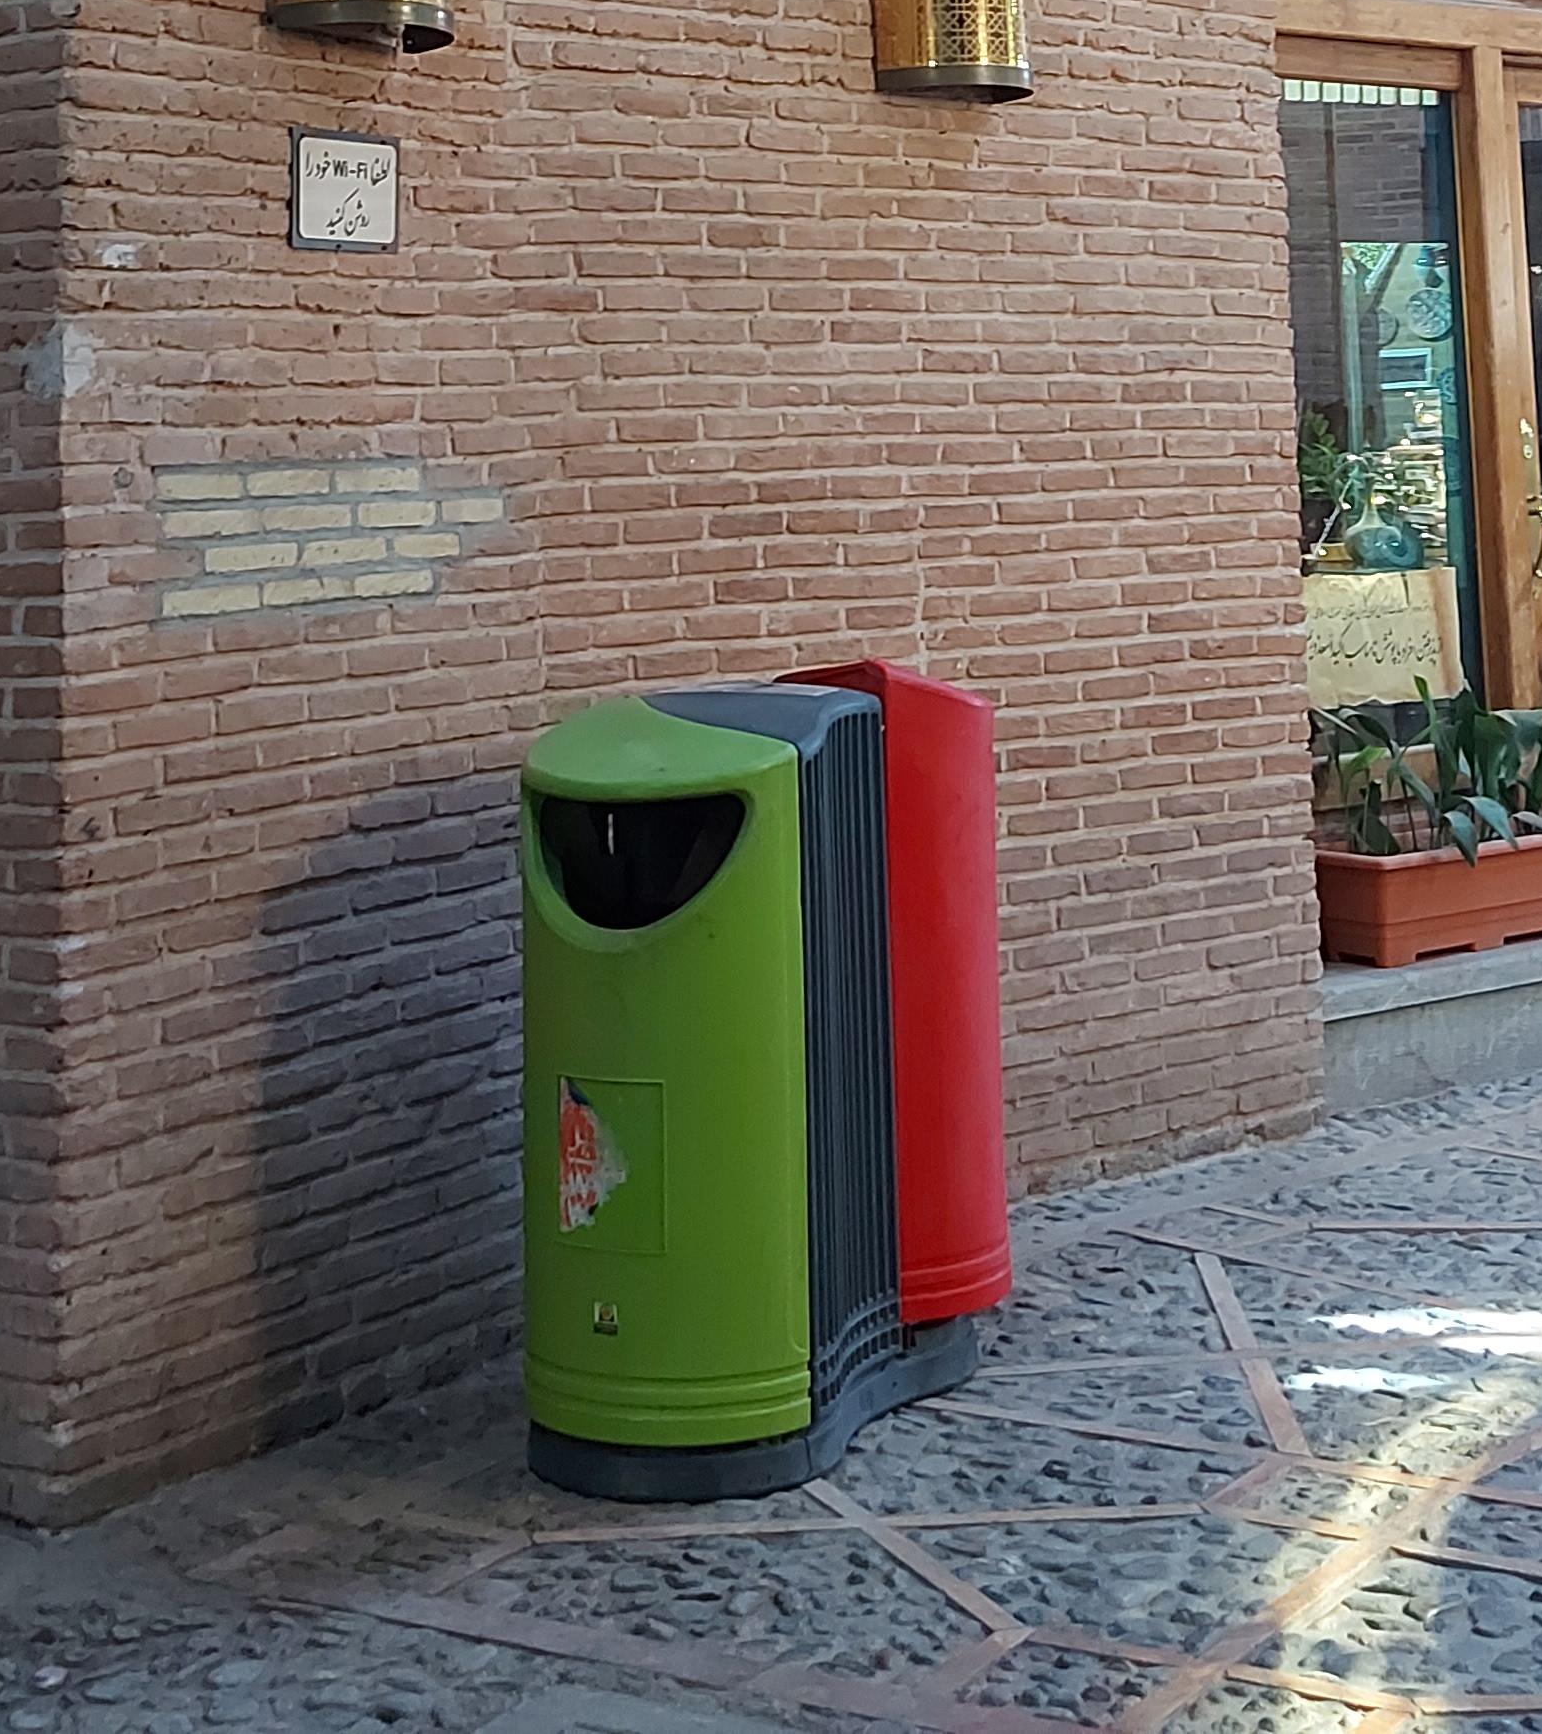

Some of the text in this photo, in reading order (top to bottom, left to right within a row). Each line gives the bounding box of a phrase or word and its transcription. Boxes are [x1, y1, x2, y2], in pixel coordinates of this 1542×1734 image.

[332, 158, 368, 180] Wi-Fi
[325, 187, 371, 237] روشن کنید
